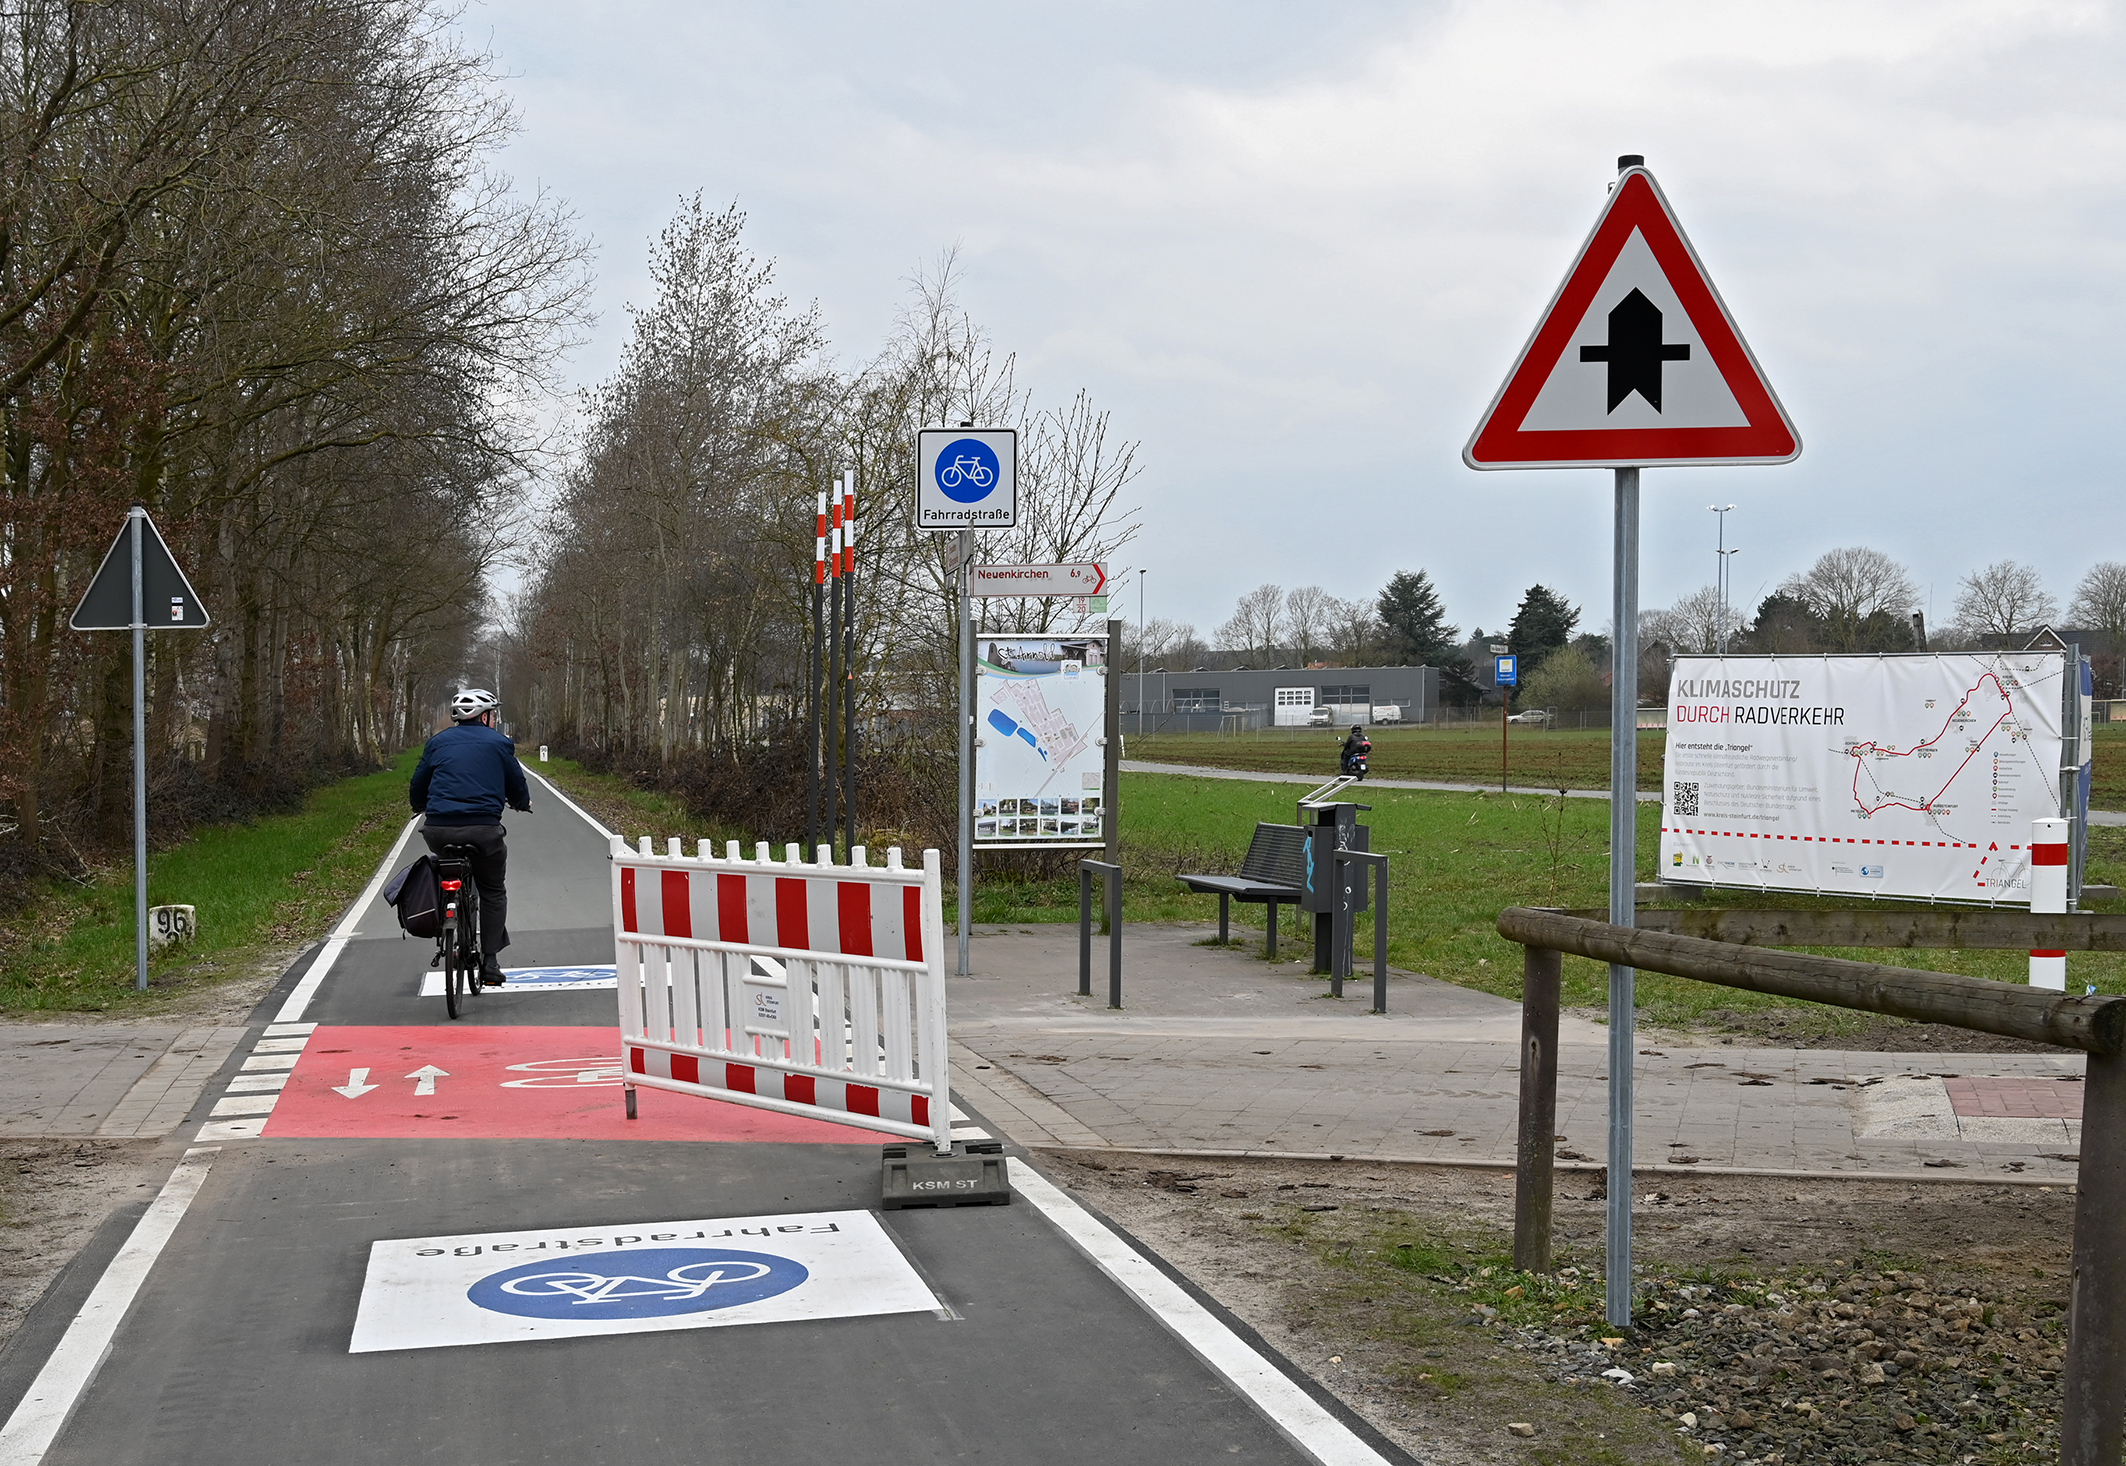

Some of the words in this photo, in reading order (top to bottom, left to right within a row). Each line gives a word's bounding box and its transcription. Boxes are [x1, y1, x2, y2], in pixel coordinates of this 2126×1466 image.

[923, 508, 1010, 520] Fahrradstraße
[978, 569, 1049, 579] Neuenkirchen
[1677, 679, 1800, 699] KLIMASCHUTZ
[1677, 705, 1730, 723] DURCH
[1734, 706, 1845, 725] RADVERKEHR
[1713, 743, 1724, 751] die
[1985, 878, 2027, 889] TRIANGEL
[157, 909, 187, 934] 96
[913, 1181, 950, 1190] KSM
[956, 1180, 978, 1189] ST
[415, 1222, 840, 1258] Fahrradstraße
